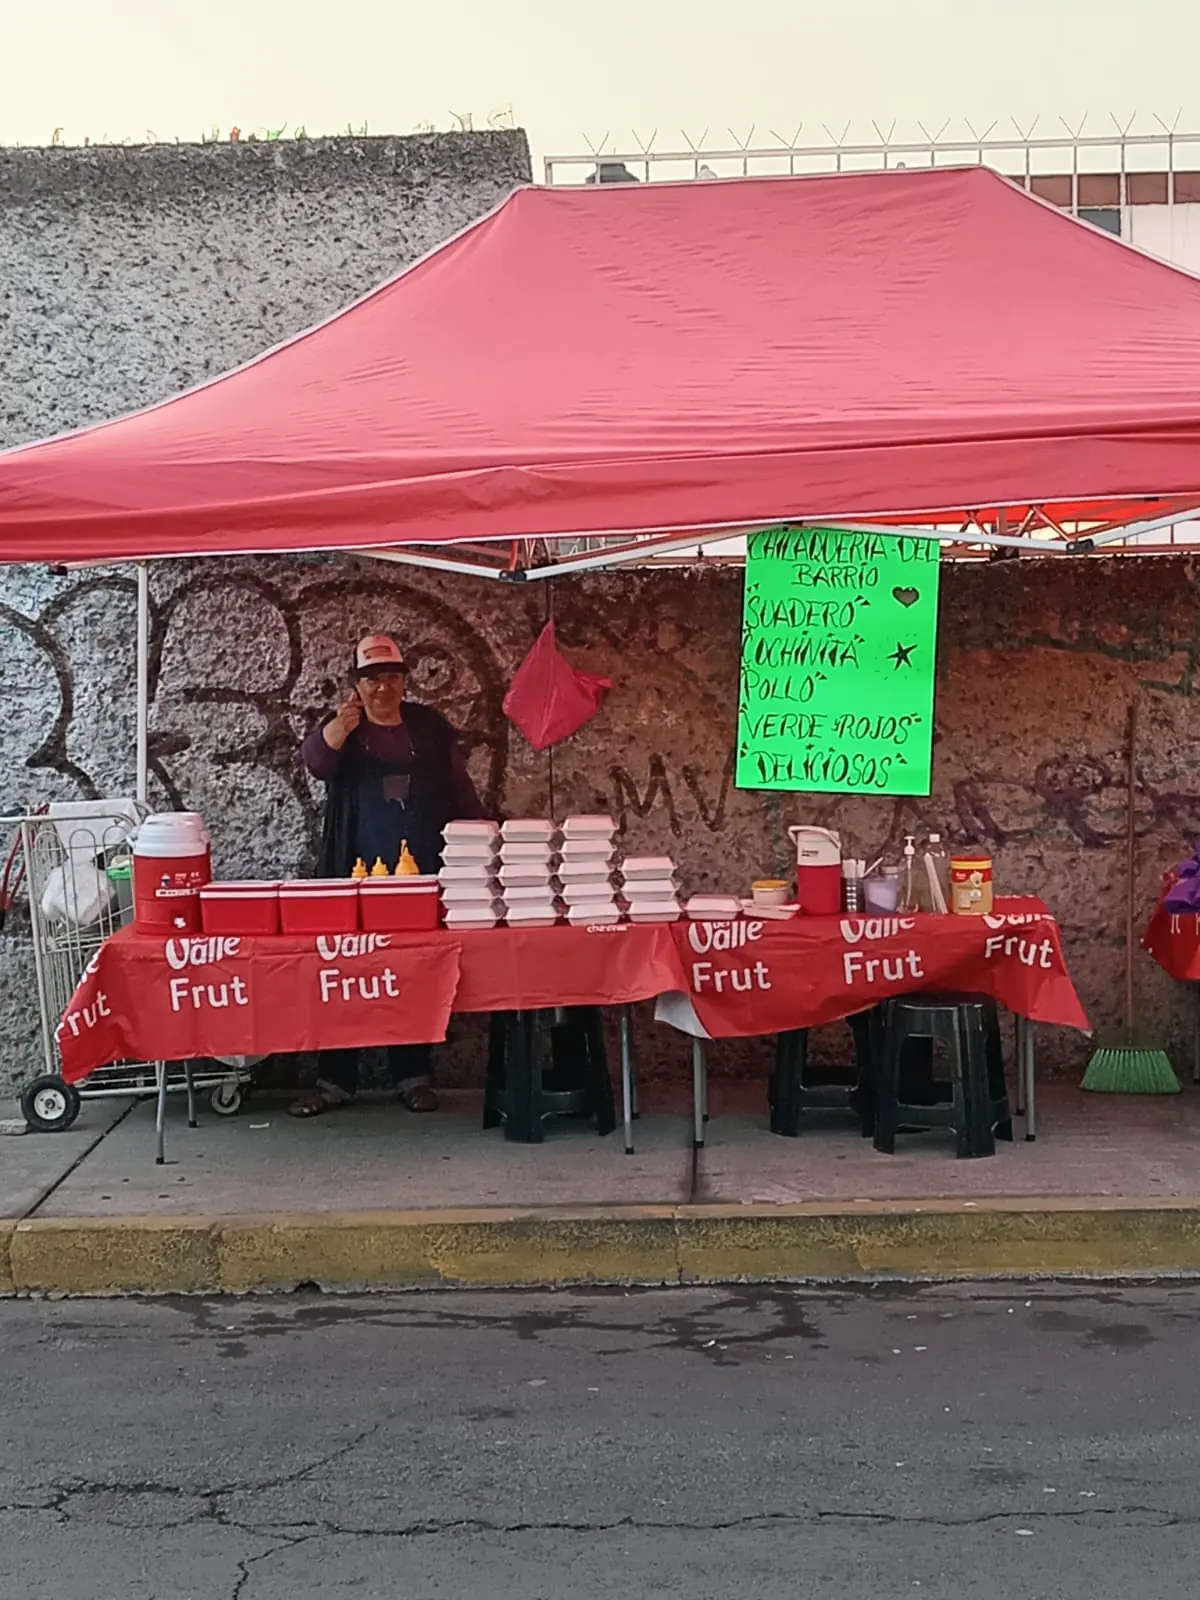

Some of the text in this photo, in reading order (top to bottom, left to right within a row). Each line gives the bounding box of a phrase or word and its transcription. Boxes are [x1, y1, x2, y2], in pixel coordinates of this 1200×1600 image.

[897, 536, 939, 562] DEL
[791, 562, 878, 589] BARRIO
[165, 936, 241, 970] Valle
[688, 921, 764, 954] Valle
[984, 935, 1054, 968] Frut
[691, 961, 772, 993] Frut
[842, 949, 924, 985] Frut
[169, 975, 249, 1012] Frut
[320, 967, 400, 1003] Frut
